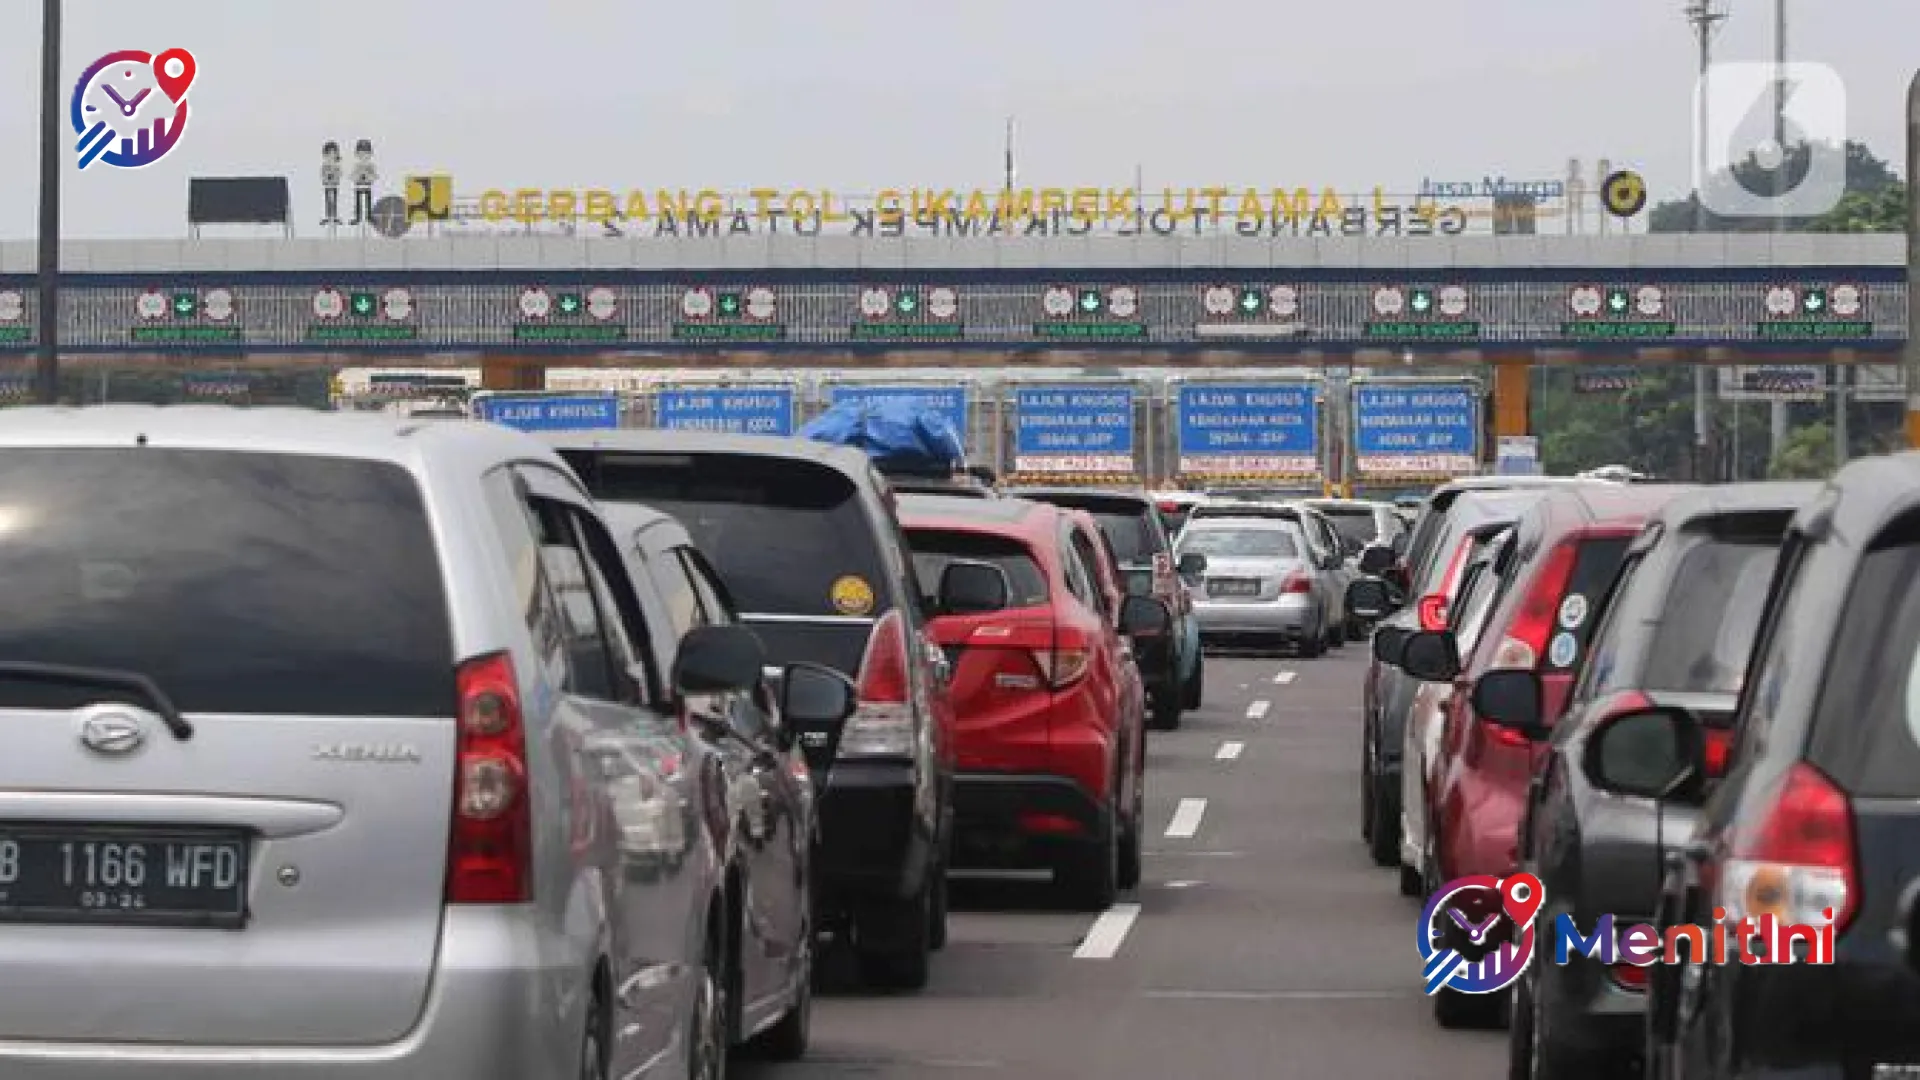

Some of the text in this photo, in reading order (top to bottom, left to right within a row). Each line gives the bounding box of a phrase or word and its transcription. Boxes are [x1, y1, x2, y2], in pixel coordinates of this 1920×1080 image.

[480, 187, 722, 223] GERBANG
[750, 187, 848, 223] TOL
[1163, 187, 1341, 222] UTAMA
[61, 843, 147, 888] 1166
[167, 844, 238, 889] WFD
